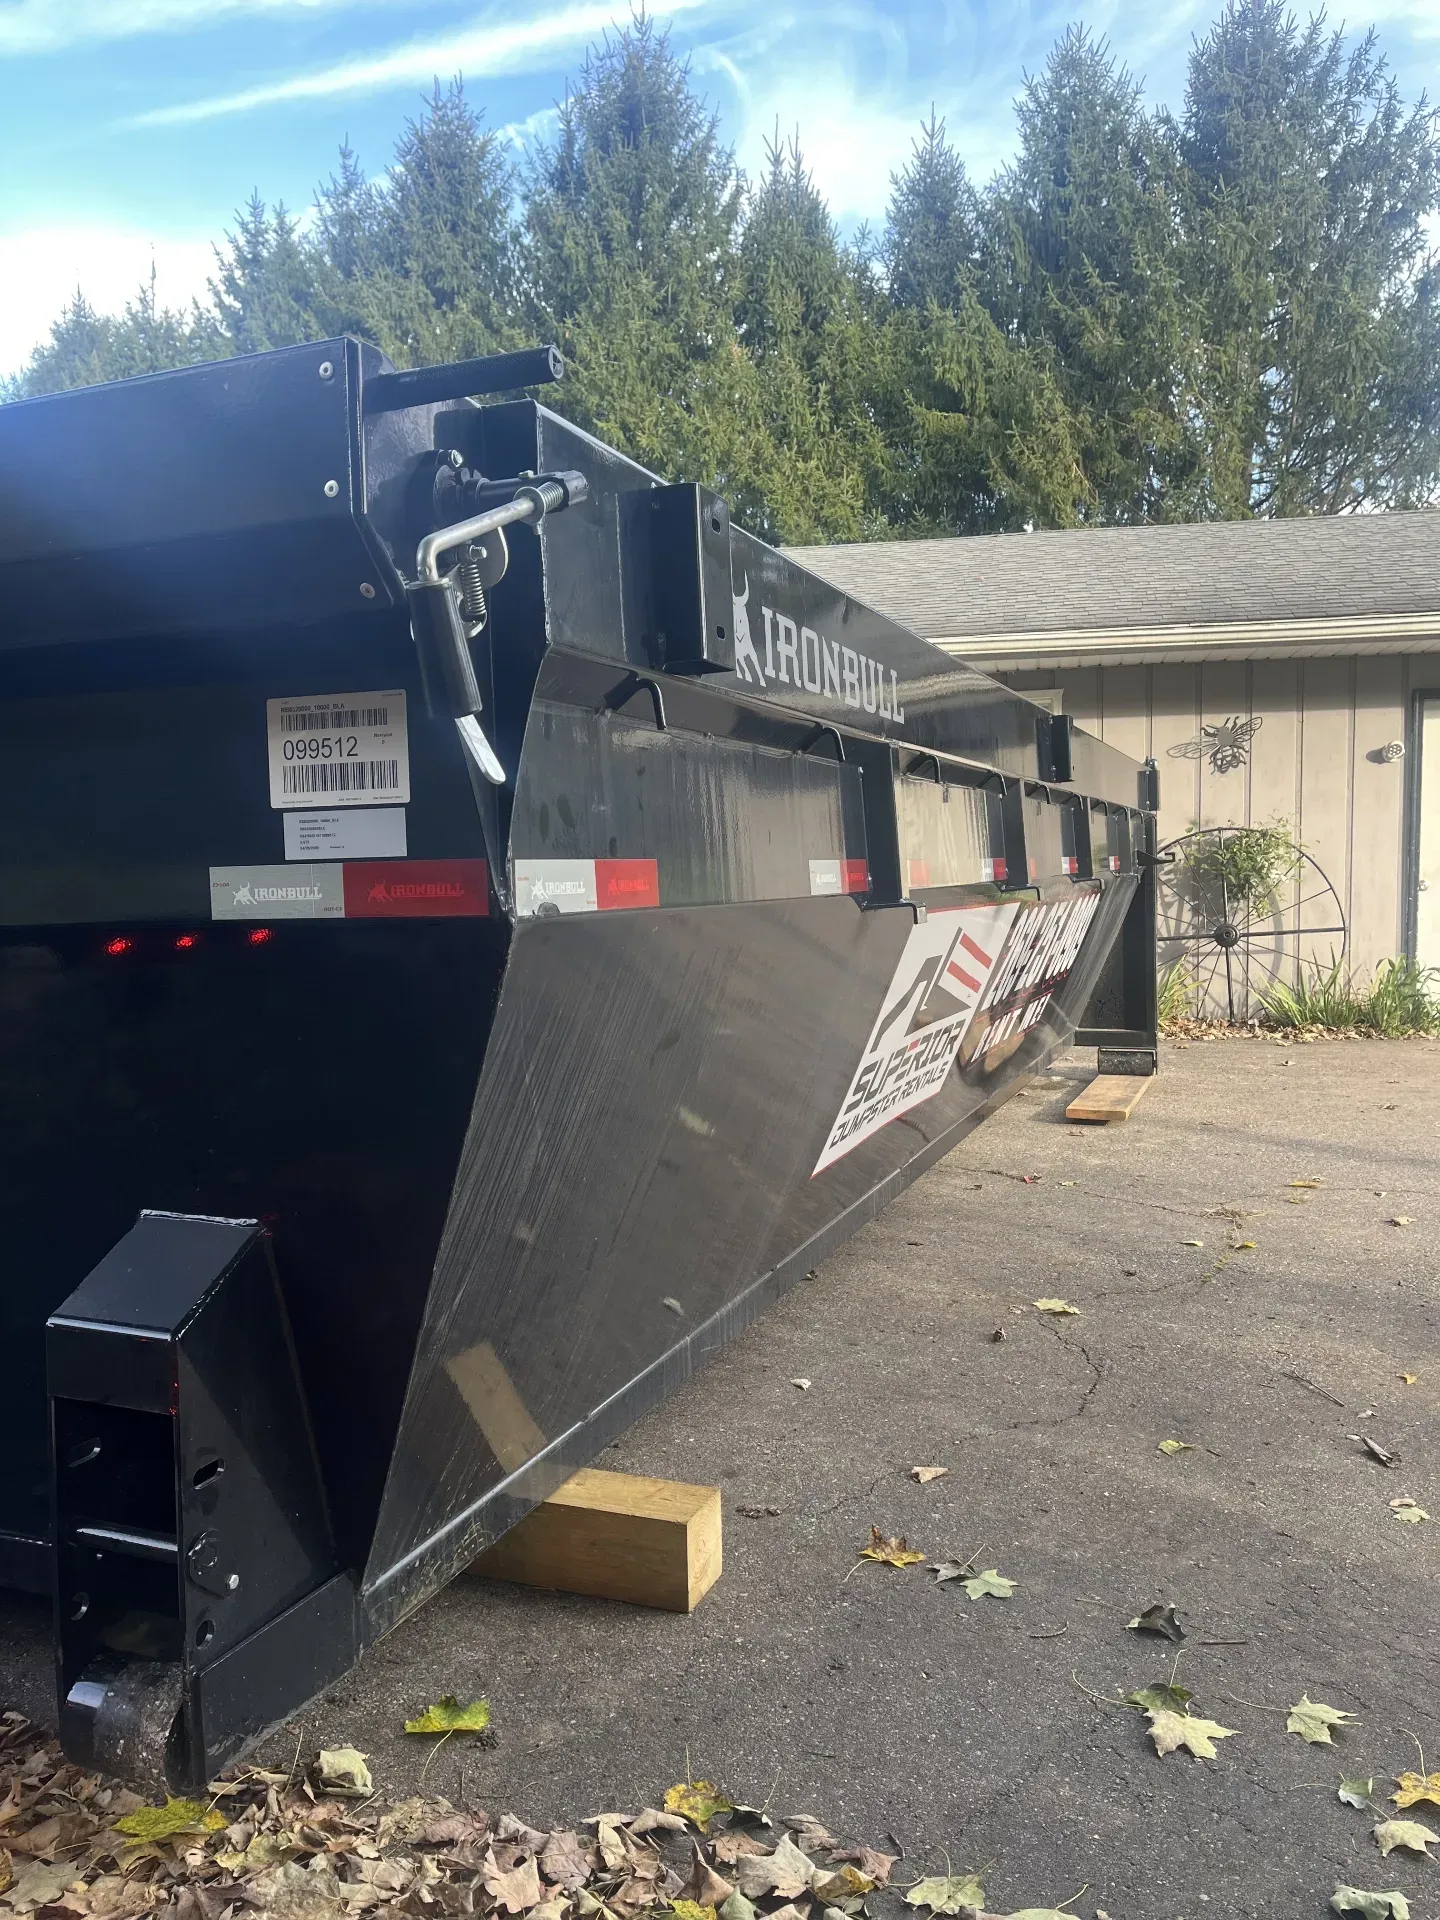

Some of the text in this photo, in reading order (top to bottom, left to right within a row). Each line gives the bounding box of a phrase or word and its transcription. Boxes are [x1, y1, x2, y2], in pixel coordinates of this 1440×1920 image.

[761, 605, 905, 725] IRONBULL
[283, 736, 359, 761] 099512
[254, 885, 323, 899] IRONBULL
[389, 882, 465, 896] IRONBULL
[545, 879, 586, 893] IRONBULL
[970, 993, 1052, 1063] RENT ME!
[843, 1018, 967, 1116] SUPERIOR
[829, 1060, 949, 1150] DUMPSTER RENTALS
